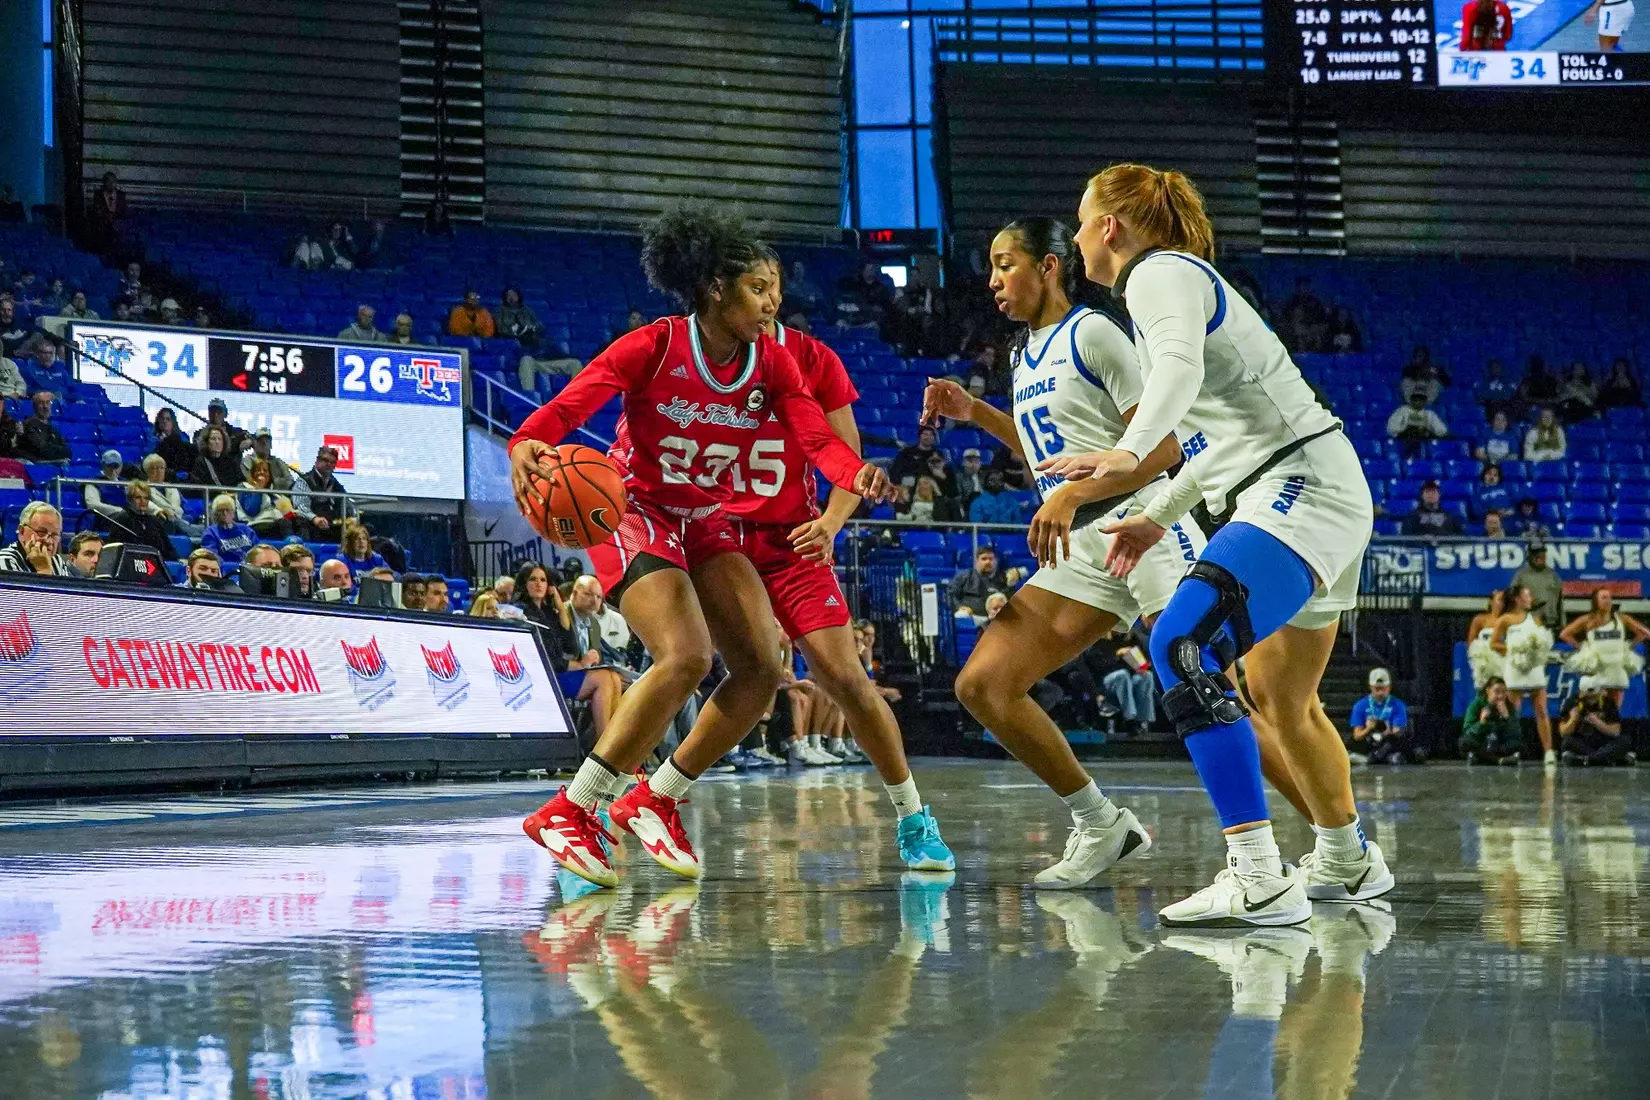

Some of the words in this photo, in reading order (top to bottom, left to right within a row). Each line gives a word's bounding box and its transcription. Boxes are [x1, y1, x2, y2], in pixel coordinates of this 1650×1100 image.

[1296, 9, 1331, 24] 25.0
[1391, 7, 1427, 23] 44.4
[1390, 29, 1430, 44] 10-12
[1304, 51, 1315, 65] 7
[1327, 51, 1400, 63] TURNOVERS
[1408, 48, 1427, 64] 12
[1561, 55, 1588, 67] TOL
[1599, 56, 1607, 67] 4
[1300, 68, 1320, 84] 10
[1327, 70, 1373, 81] LARGEST
[1374, 69, 1402, 80] LEAD
[1412, 66, 1424, 82] 2
[1511, 58, 1546, 80] 34
[1562, 69, 1604, 81] FOULS
[1614, 69, 1623, 80] 0
[147, 341, 199, 378] 34
[242, 344, 304, 375] 7:56
[259, 376, 287, 394] 3rd
[343, 355, 394, 394] 26
[1015, 377, 1056, 405] MIDDLE
[656, 396, 700, 429] Lady
[698, 403, 759, 429] Techsters
[1021, 405, 1065, 463] 15
[134, 559, 147, 574] POSS
[1435, 543, 1590, 570] STUDNT
[82, 636, 321, 693] GATEWAYTIRE.COM
